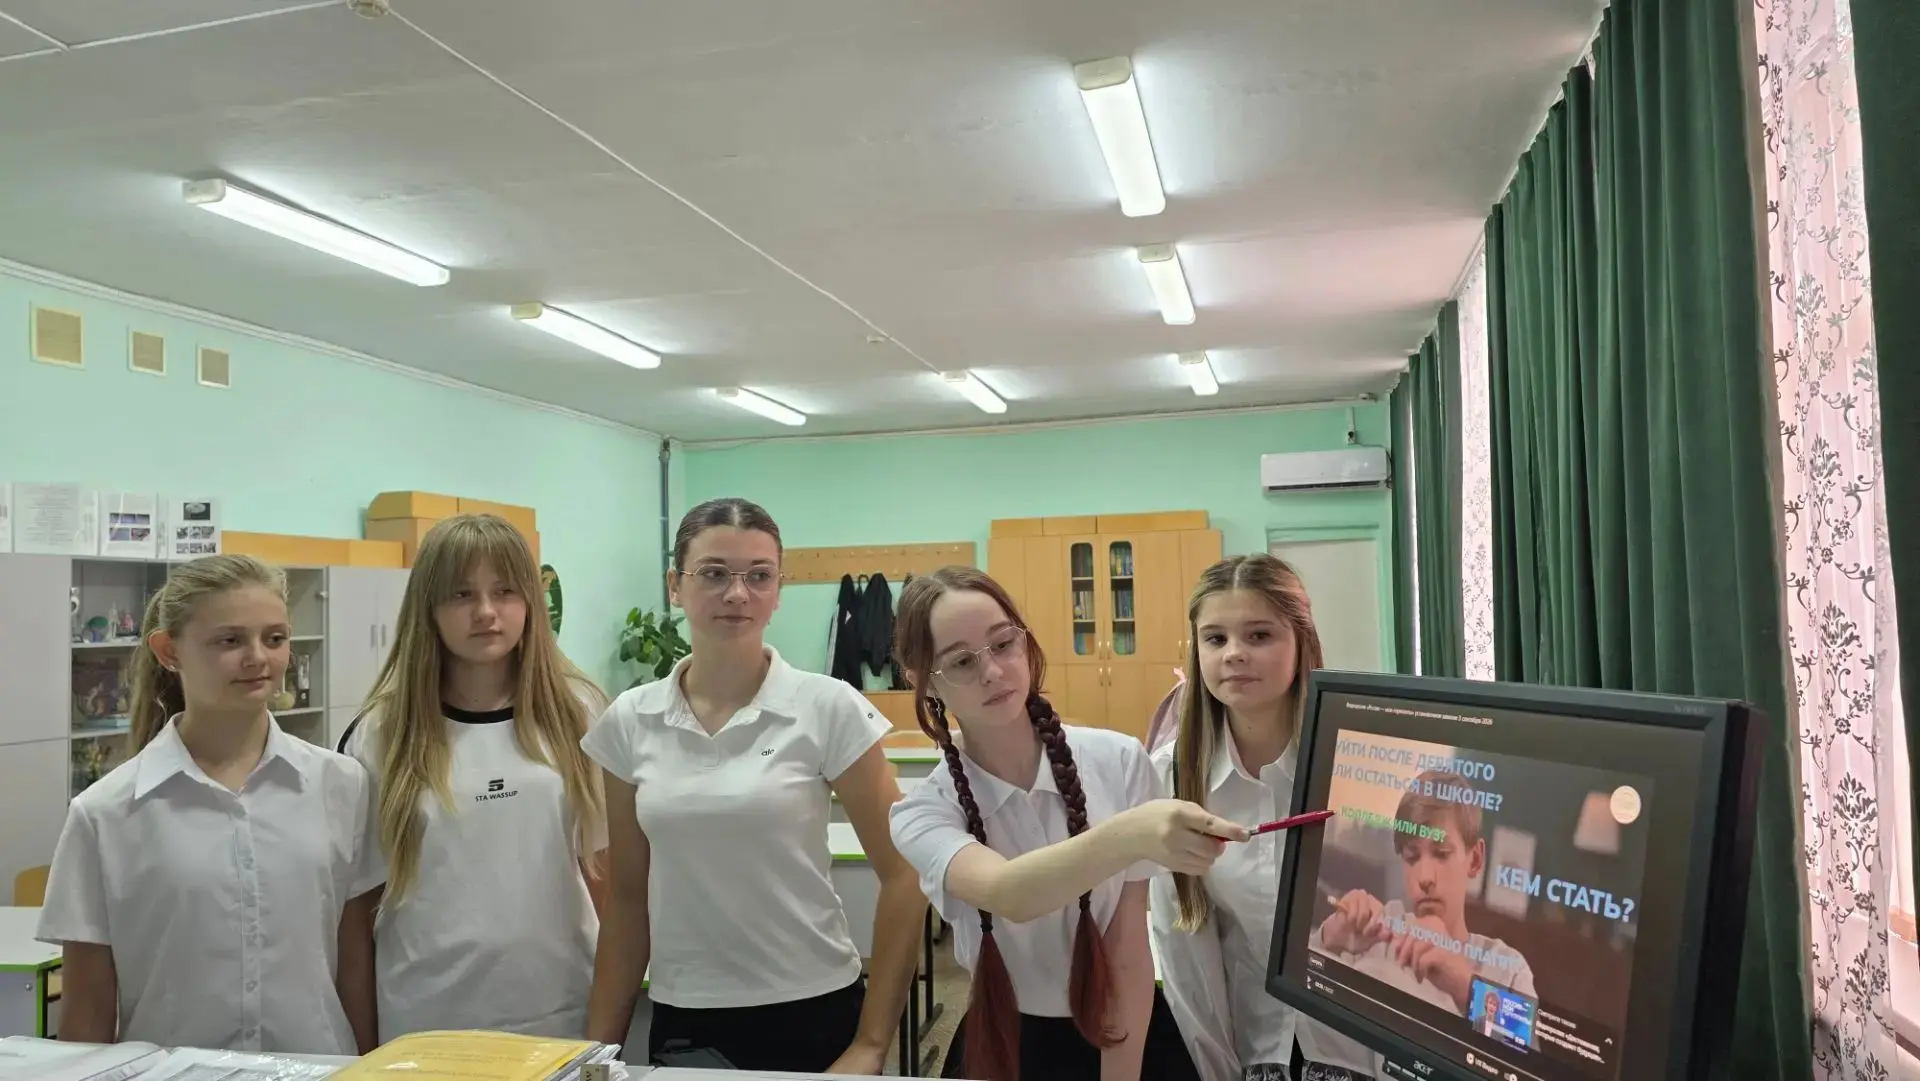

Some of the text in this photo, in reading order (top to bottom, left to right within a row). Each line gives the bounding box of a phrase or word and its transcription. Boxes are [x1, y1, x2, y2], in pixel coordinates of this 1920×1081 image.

[1369, 745, 1413, 766] ПОСЛЕ
[1416, 753, 1496, 782] ДЕВЯТОГО
[1333, 763, 1504, 812] ЛИ ОСТАТЬСЯ В ШКОЛЕ?
[1394, 818, 1417, 835] ИЛИ
[1419, 827, 1447, 842] ВУЗ?
[1496, 865, 1636, 923] КЕМ СТАТЬ?
[1409, 924, 1462, 953] ХОРОШО
[1413, 1060, 1434, 1075] acer
